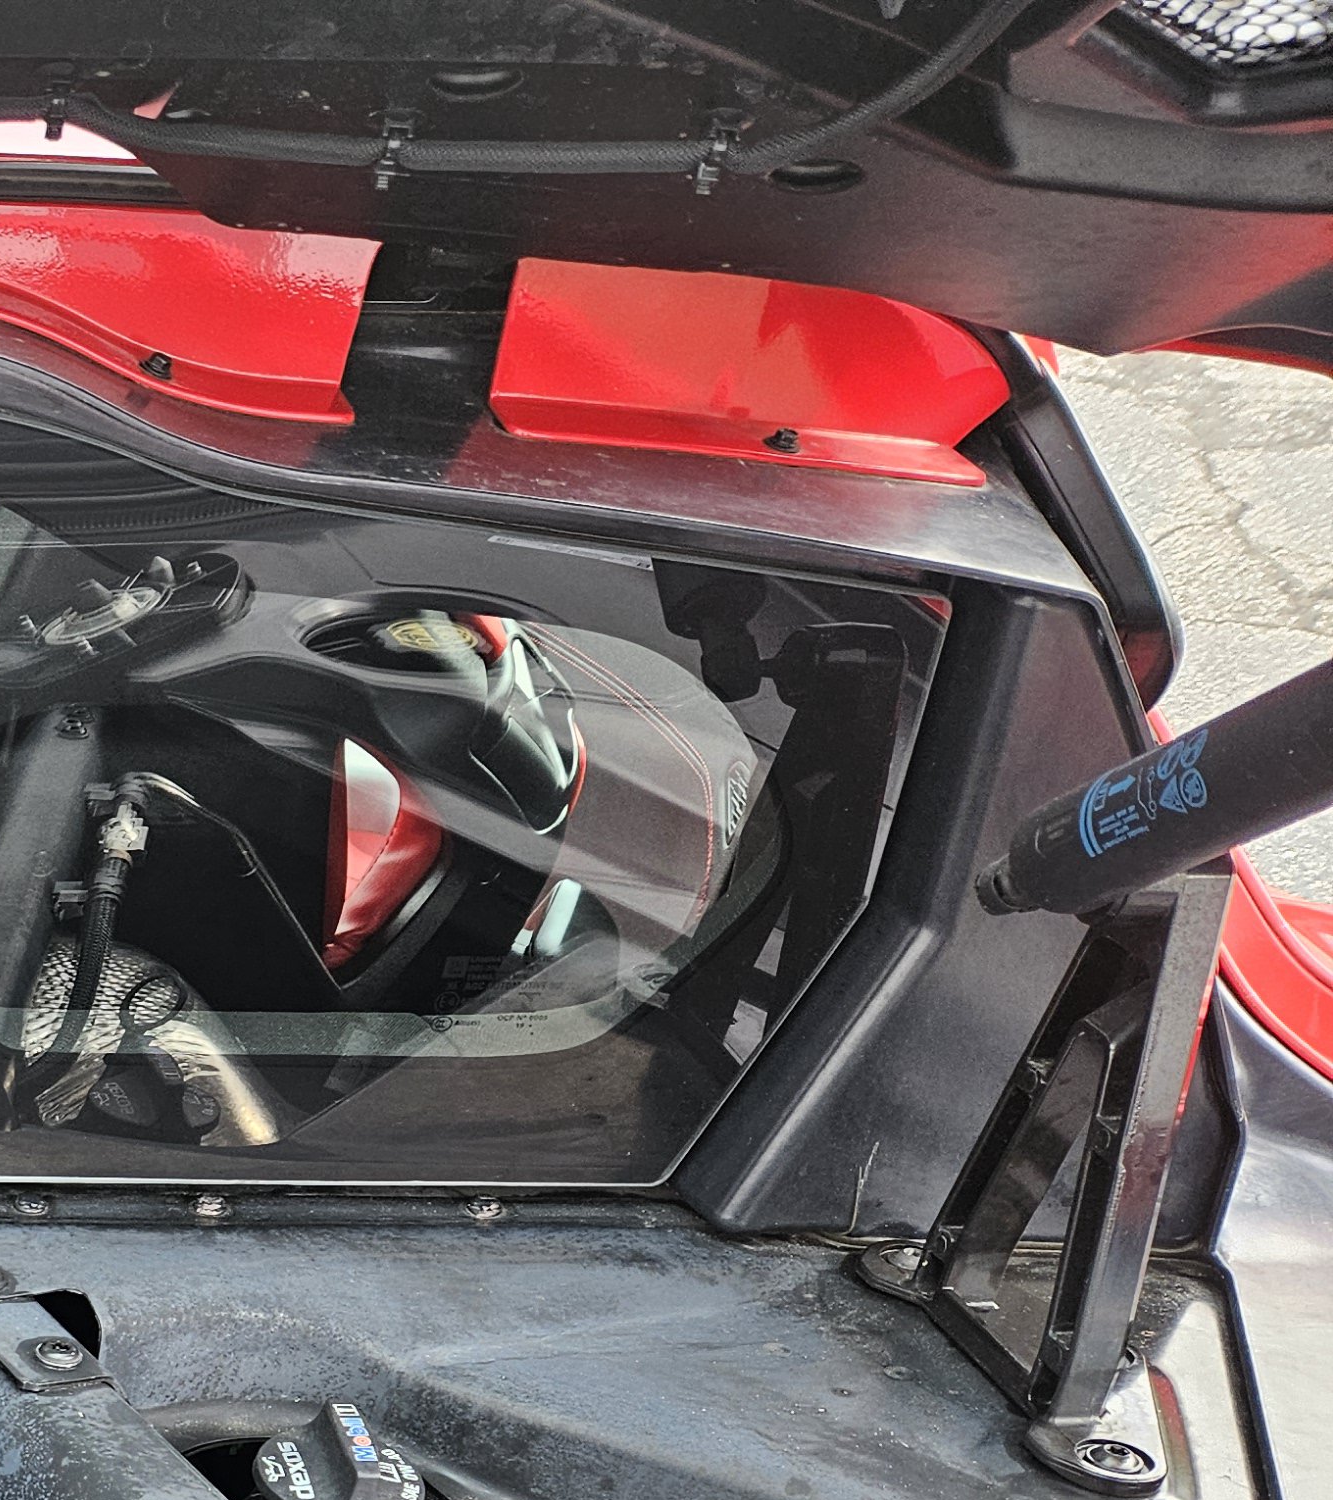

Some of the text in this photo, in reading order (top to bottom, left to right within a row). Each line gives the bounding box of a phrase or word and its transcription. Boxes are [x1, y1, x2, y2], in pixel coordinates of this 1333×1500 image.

[339, 1417, 378, 1462] Mobil
[277, 1441, 315, 1500] dexos
[381, 1448, 419, 1481] 0W-40
